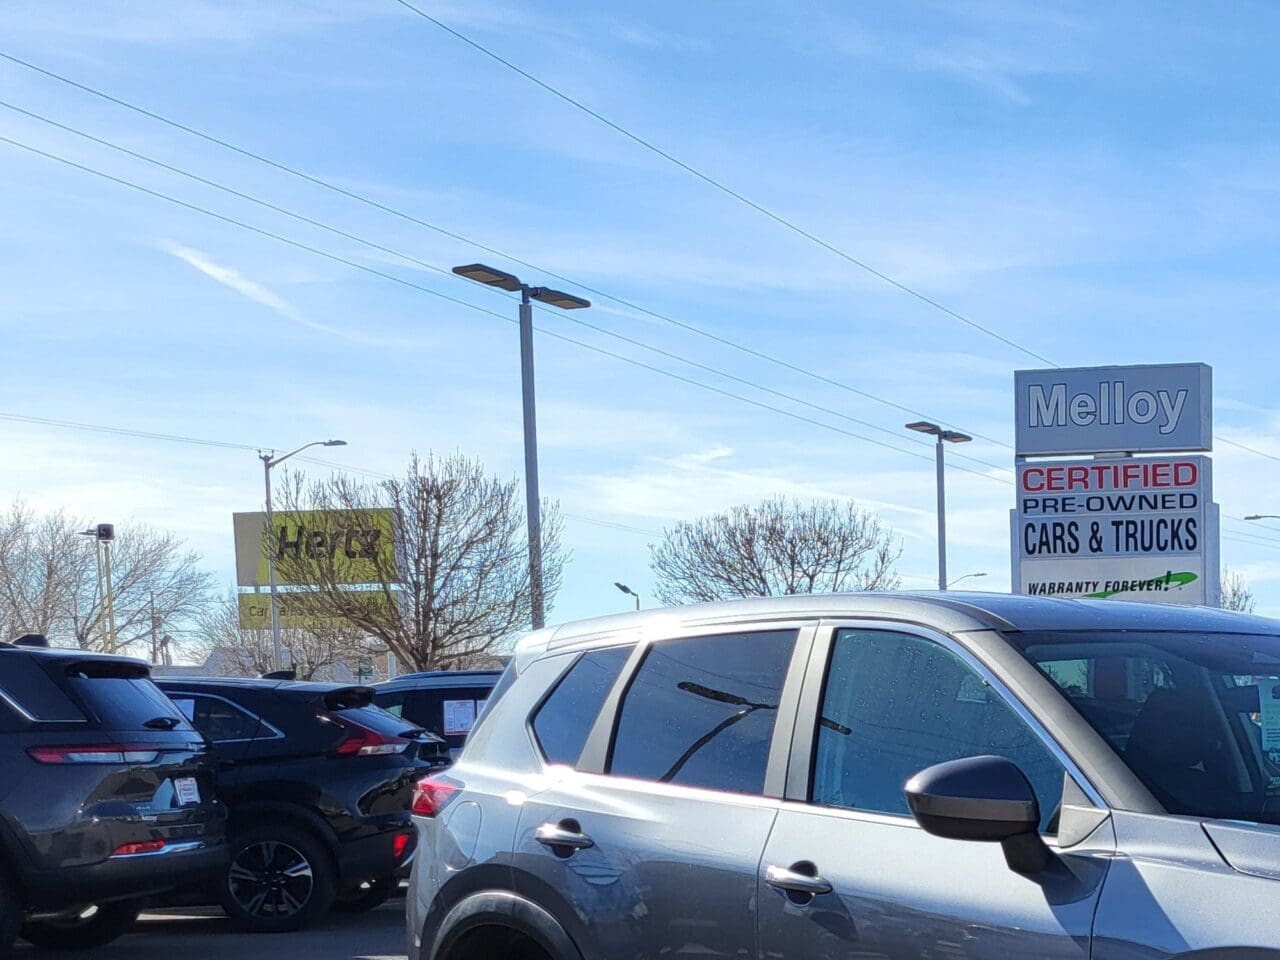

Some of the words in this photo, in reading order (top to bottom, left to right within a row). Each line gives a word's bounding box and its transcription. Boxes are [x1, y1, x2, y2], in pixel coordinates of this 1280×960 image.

[1028, 381, 1188, 434] Melloy
[1022, 462, 1198, 492] CERTIFIED
[1023, 493, 1198, 513] PRE-OWNED
[278, 526, 381, 560] Hertz
[1024, 521, 1080, 555] CARS
[1088, 521, 1103, 553] &
[1111, 517, 1198, 553] TRUCKS
[1028, 581, 1100, 595] WARRANTY
[1104, 570, 1171, 593] FOREVER!
